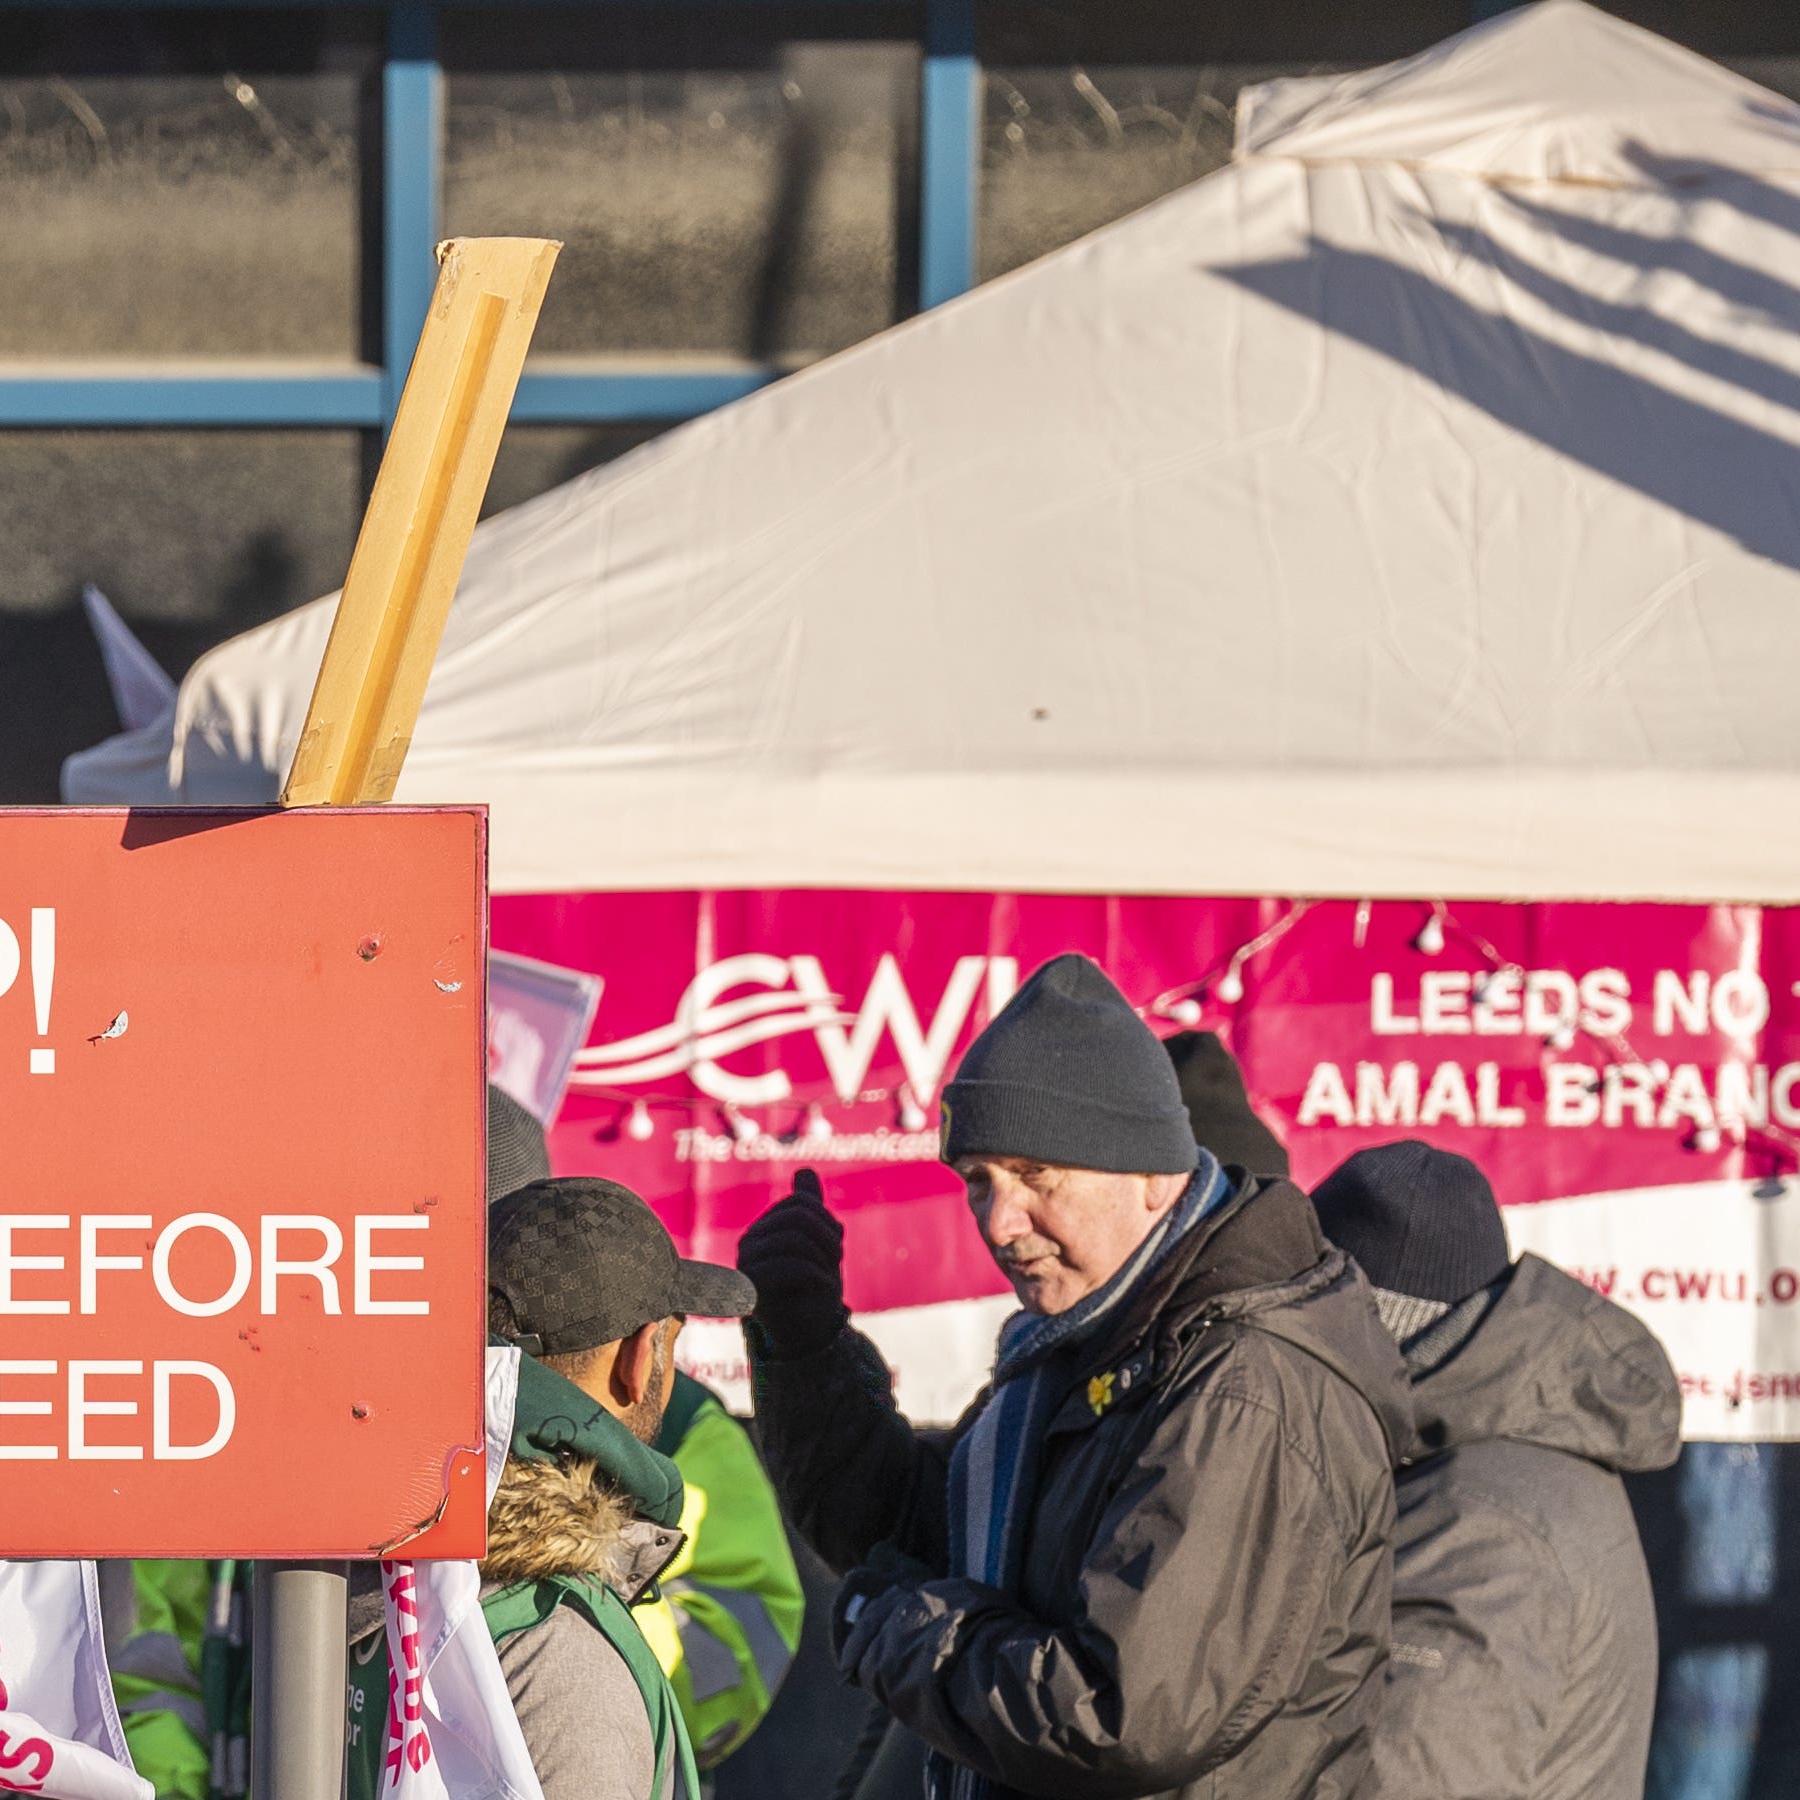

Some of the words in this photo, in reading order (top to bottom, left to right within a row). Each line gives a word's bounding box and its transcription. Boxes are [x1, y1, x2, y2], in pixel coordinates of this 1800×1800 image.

[1371, 968, 1633, 1037] LEEDS
[1653, 968, 1771, 1038] NO
[1297, 1061, 1525, 1128] AMAL
[674, 1127, 732, 1162] The
